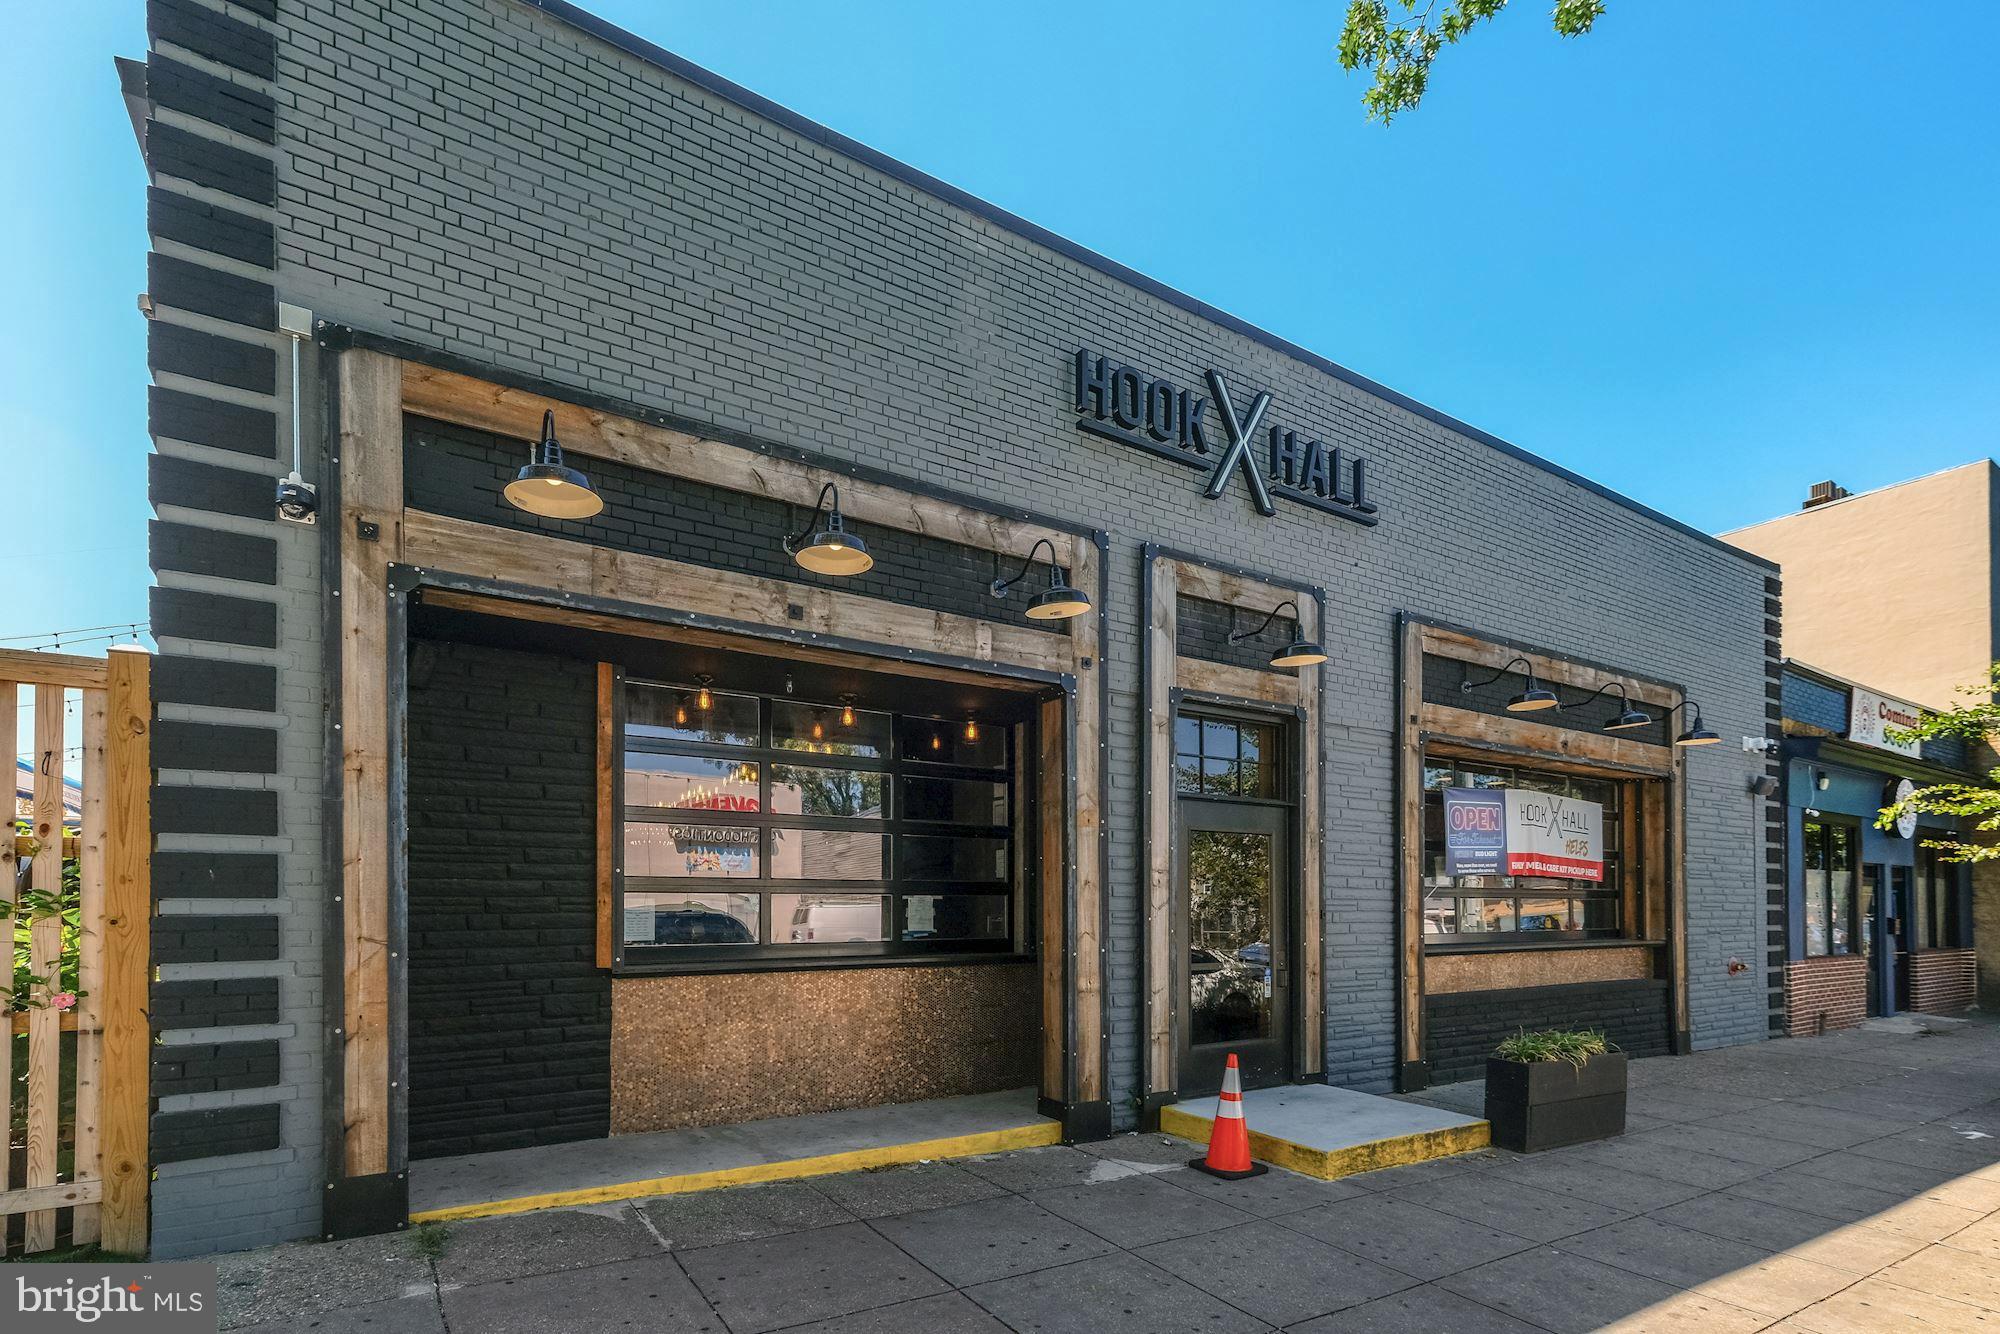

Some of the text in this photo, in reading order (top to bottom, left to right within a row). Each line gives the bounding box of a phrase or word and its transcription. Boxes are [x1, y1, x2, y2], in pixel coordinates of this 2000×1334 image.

[1075, 349, 1378, 517] HOOK X HALL
[1879, 701, 1917, 729] Coming
[1450, 805, 1501, 831] OPEN
[1520, 803, 1547, 824] HOOK
[1562, 810, 1589, 831] HALL
